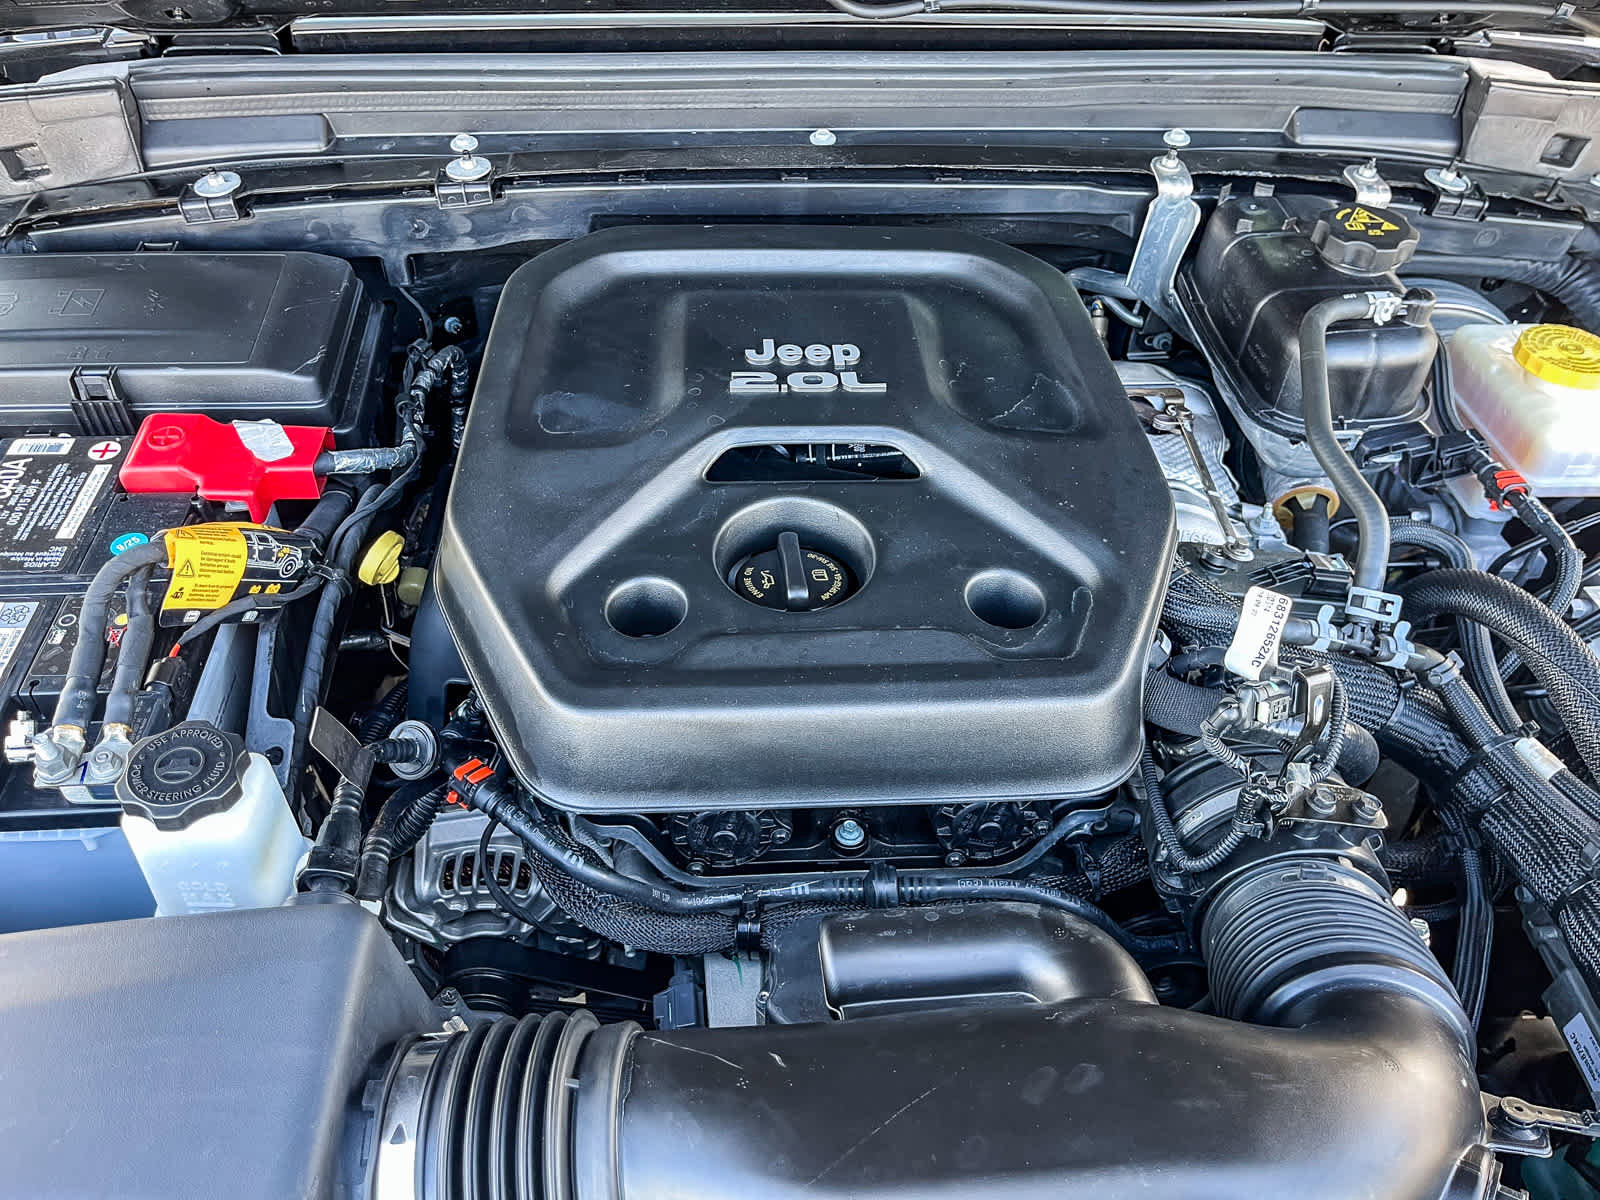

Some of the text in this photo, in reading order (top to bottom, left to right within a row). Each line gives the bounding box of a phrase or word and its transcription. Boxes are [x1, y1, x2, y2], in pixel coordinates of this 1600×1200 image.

[745, 339, 861, 370] Jeep
[730, 371, 888, 393] 2.0L
[115, 536, 140, 551] 9/25
[743, 567, 765, 599] ENGINE OIL
[1251, 597, 1288, 668] 68312652AC
[146, 729, 224, 752] USE APPROVED
[130, 761, 226, 802] POWER STEERING FLUID
